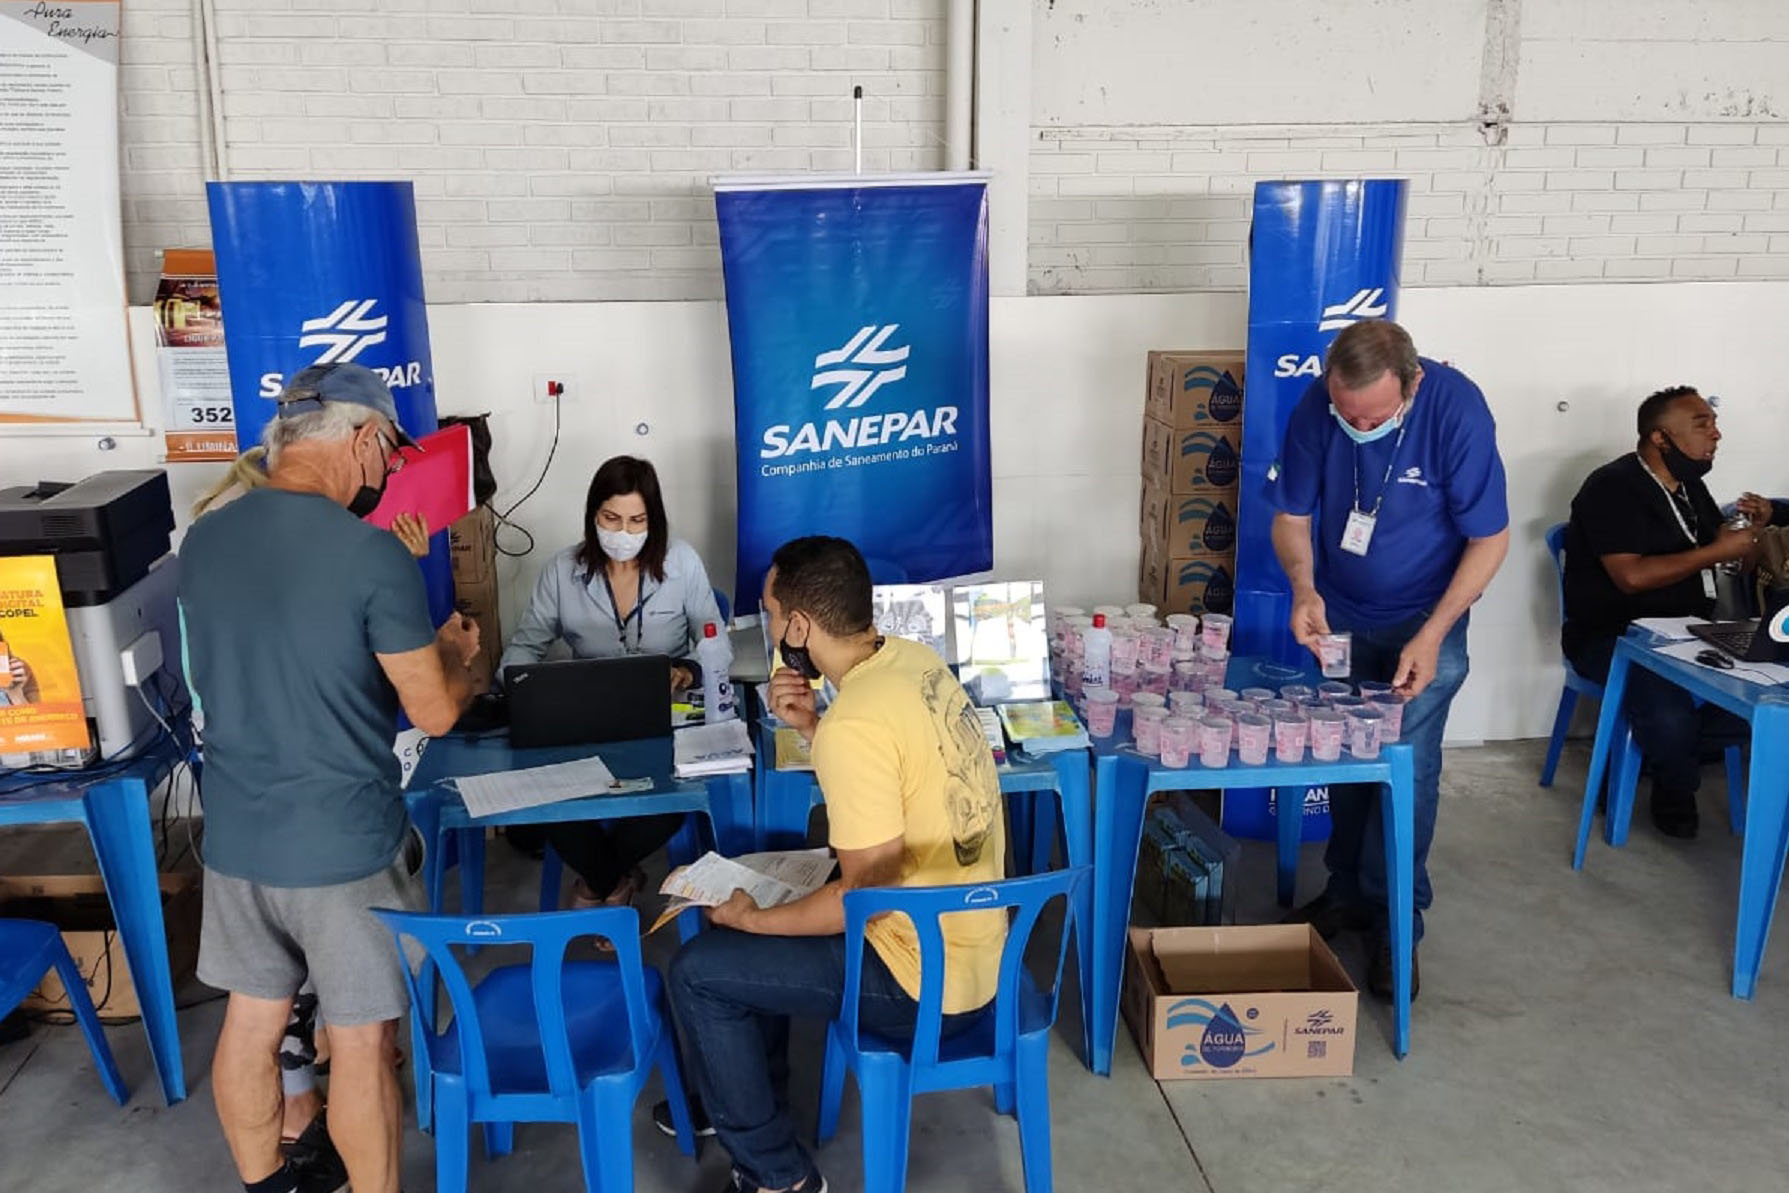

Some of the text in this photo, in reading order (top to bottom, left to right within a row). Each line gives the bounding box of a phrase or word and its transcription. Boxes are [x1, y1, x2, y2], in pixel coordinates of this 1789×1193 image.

[259, 361, 421, 398] SPAR
[191, 407, 233, 422] 352
[760, 406, 958, 459] SANEPAR
[761, 460, 826, 477] Companhia
[828, 457, 843, 468] de
[844, 449, 910, 467] Saneamento
[911, 446, 925, 457] do
[0, 590, 44, 599] ATURA
[1204, 1031, 1245, 1045] ÁGUA
